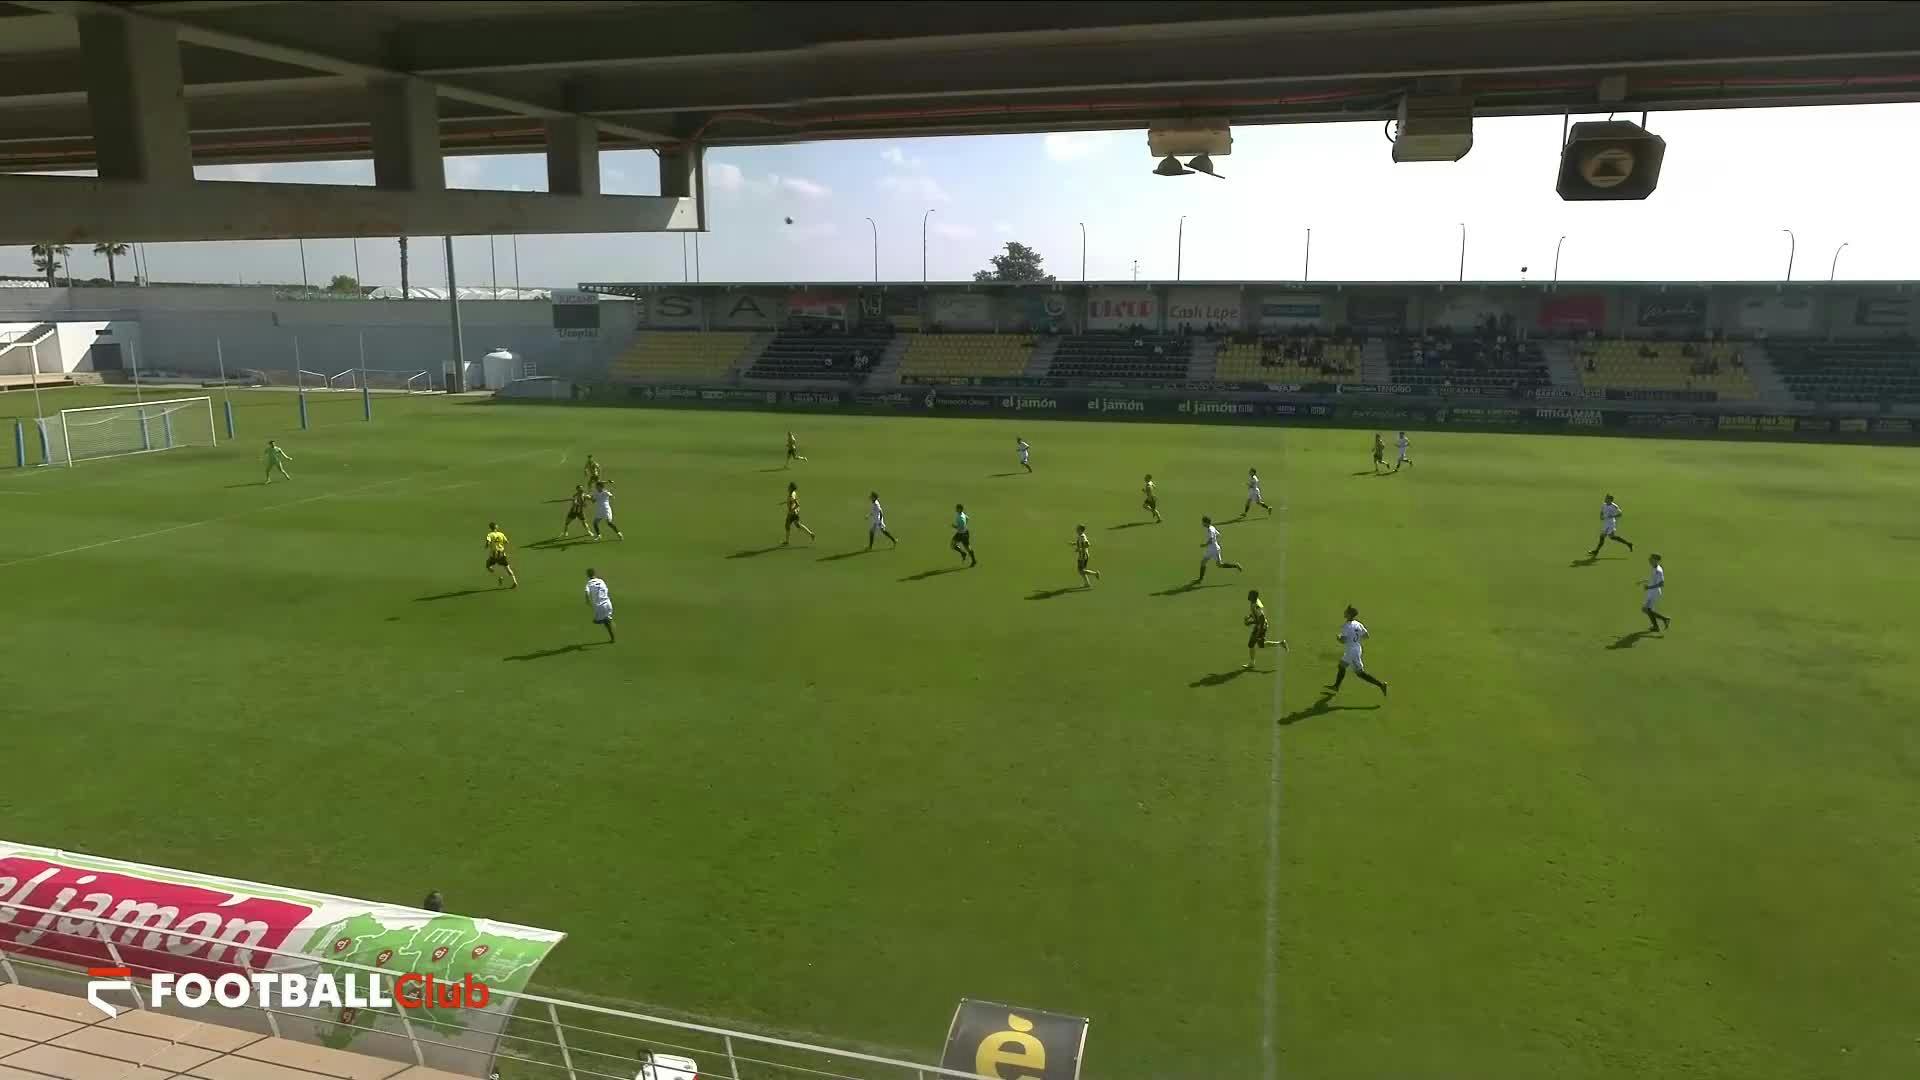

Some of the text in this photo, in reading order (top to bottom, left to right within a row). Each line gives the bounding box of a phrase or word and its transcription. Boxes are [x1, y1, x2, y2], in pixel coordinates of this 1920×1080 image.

[655, 296, 693, 318] S
[728, 296, 767, 318] A
[1169, 303, 1203, 319] Cash
[1206, 304, 1239, 321] Lepe
[1002, 396, 1015, 408] el
[1015, 397, 1057, 410] jamón
[1087, 398, 1144, 412] el jamón
[1177, 400, 1189, 412] el
[1190, 401, 1237, 415] jamón
